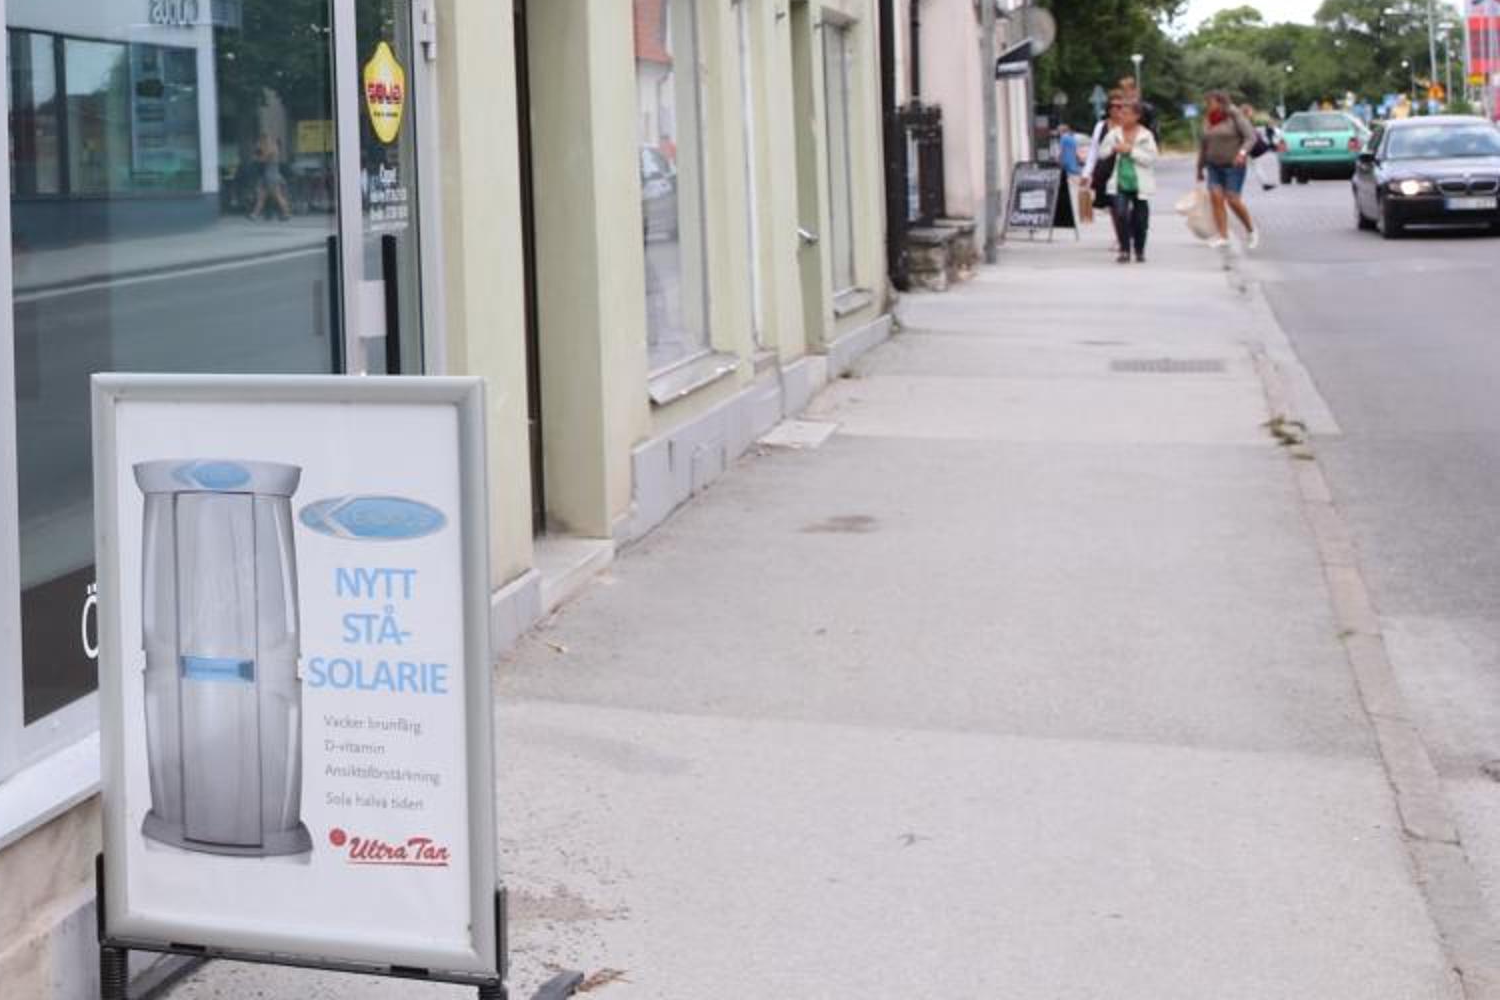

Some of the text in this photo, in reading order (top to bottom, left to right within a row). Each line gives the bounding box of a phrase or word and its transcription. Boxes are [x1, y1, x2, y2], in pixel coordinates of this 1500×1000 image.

[336, 567, 417, 600] NYTT
[342, 604, 412, 645] STÅ-
[307, 656, 450, 695] SOLARIE
[323, 713, 365, 729] Vacker
[324, 739, 385, 754] D-vitamin
[325, 791, 424, 810] Sola halva tiden
[349, 836, 451, 861] Ultra Tan
